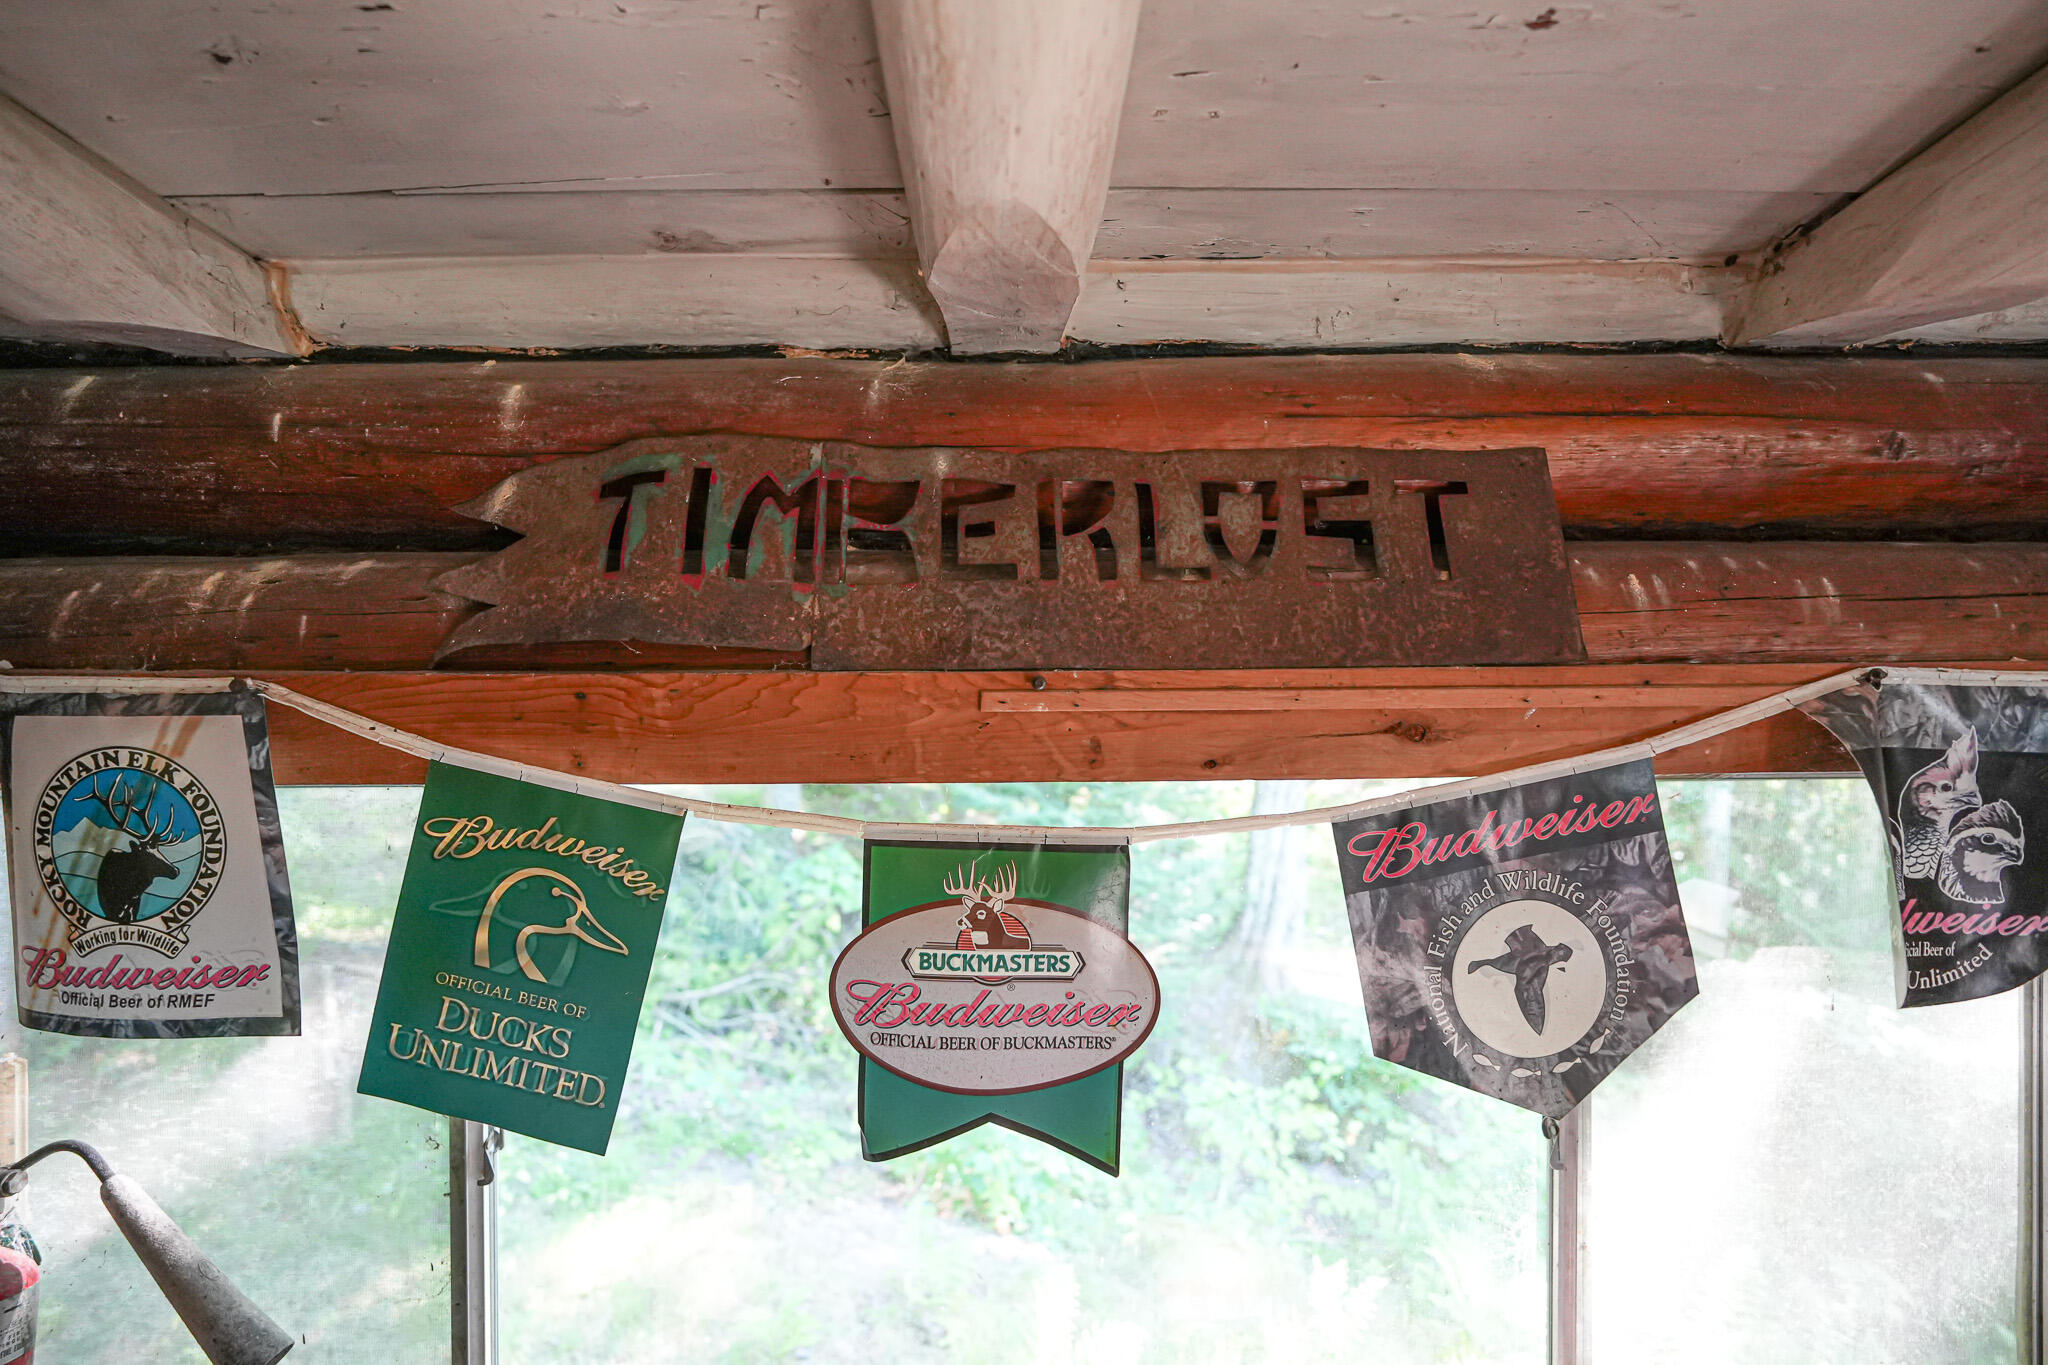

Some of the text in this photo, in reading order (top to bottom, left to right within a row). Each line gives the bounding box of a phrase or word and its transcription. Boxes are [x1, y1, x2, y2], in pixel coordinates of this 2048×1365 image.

[37, 750, 224, 930] ROCKY MOUNTAIN ELK FOUNDATION
[423, 815, 665, 902] Budweiser
[1347, 792, 1656, 883] Budweiser
[75, 927, 180, 956] Working for Wildlife
[918, 951, 1071, 974] BUCKMASTERS
[1424, 868, 1636, 1058] National Fish and Wildlife Foundation
[1923, 941, 1944, 958] Beer
[1945, 940, 1957, 957] of
[21, 945, 271, 991] Budweiser
[1907, 942, 1994, 990] Unlimited
[60, 991, 215, 1009] Official Beer of RMEF
[435, 971, 588, 1019] OFFICIAL BEER OF
[846, 978, 1142, 1029] Budweiser
[435, 995, 573, 1059] DUCKS
[870, 1031, 936, 1050] OFFICIAL
[939, 1036, 977, 1051] BEER
[980, 1036, 1001, 1050] OF
[388, 1022, 607, 1108] UNLIMITED
